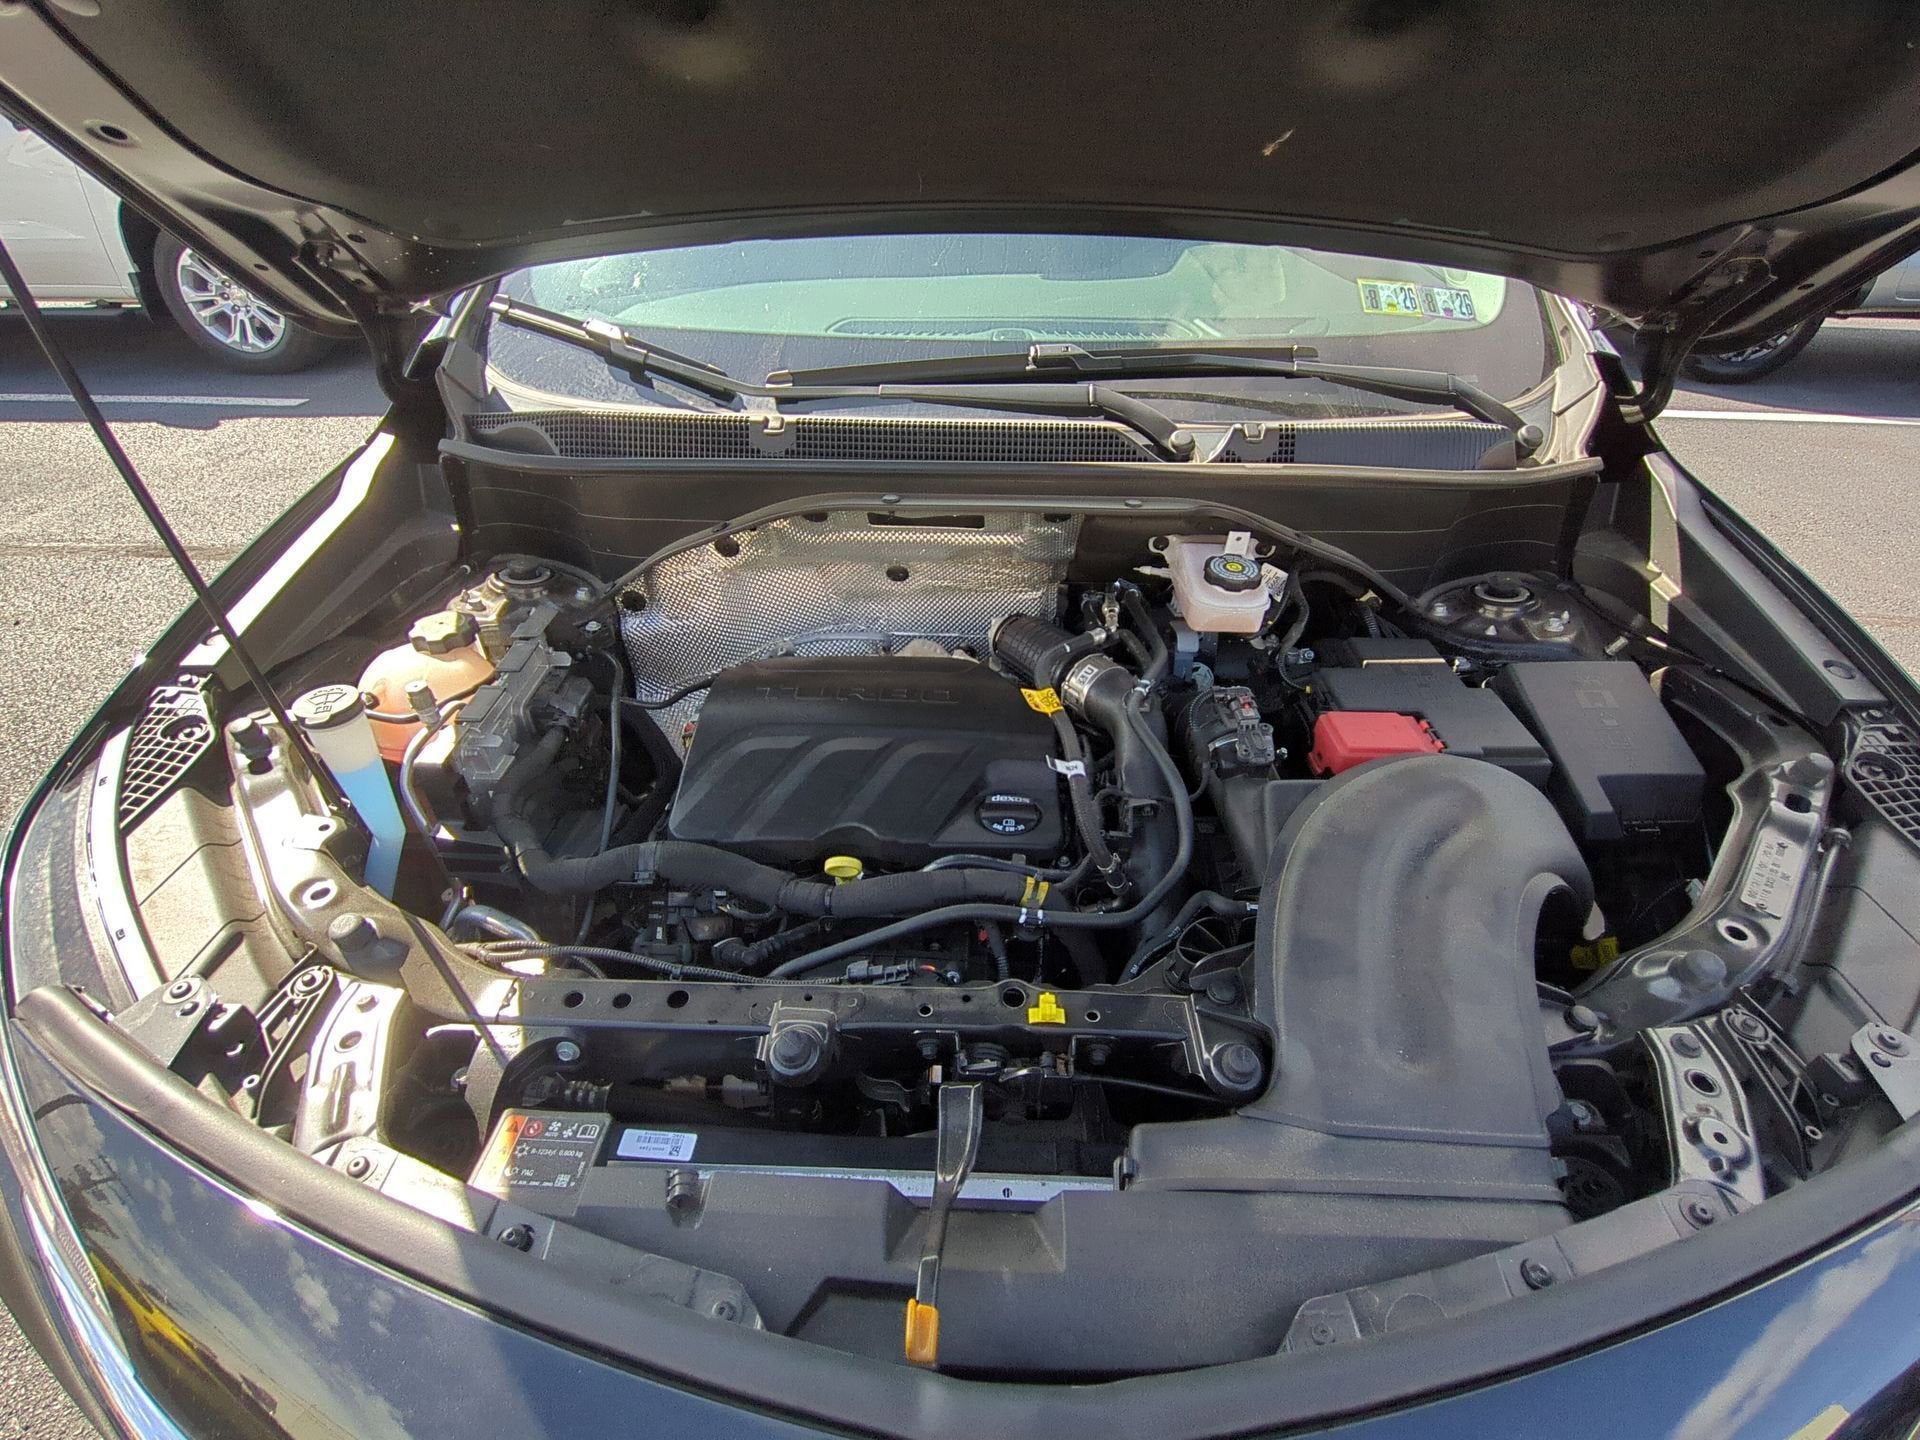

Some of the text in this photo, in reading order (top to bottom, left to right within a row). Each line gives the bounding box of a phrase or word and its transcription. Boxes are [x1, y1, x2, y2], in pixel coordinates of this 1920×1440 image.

[1368, 286, 1418, 310] 8 26
[1424, 292, 1473, 316] 8 26
[756, 686, 960, 704] TURBO
[991, 794, 1031, 804] dexos
[520, 1168, 535, 1177] PAG
